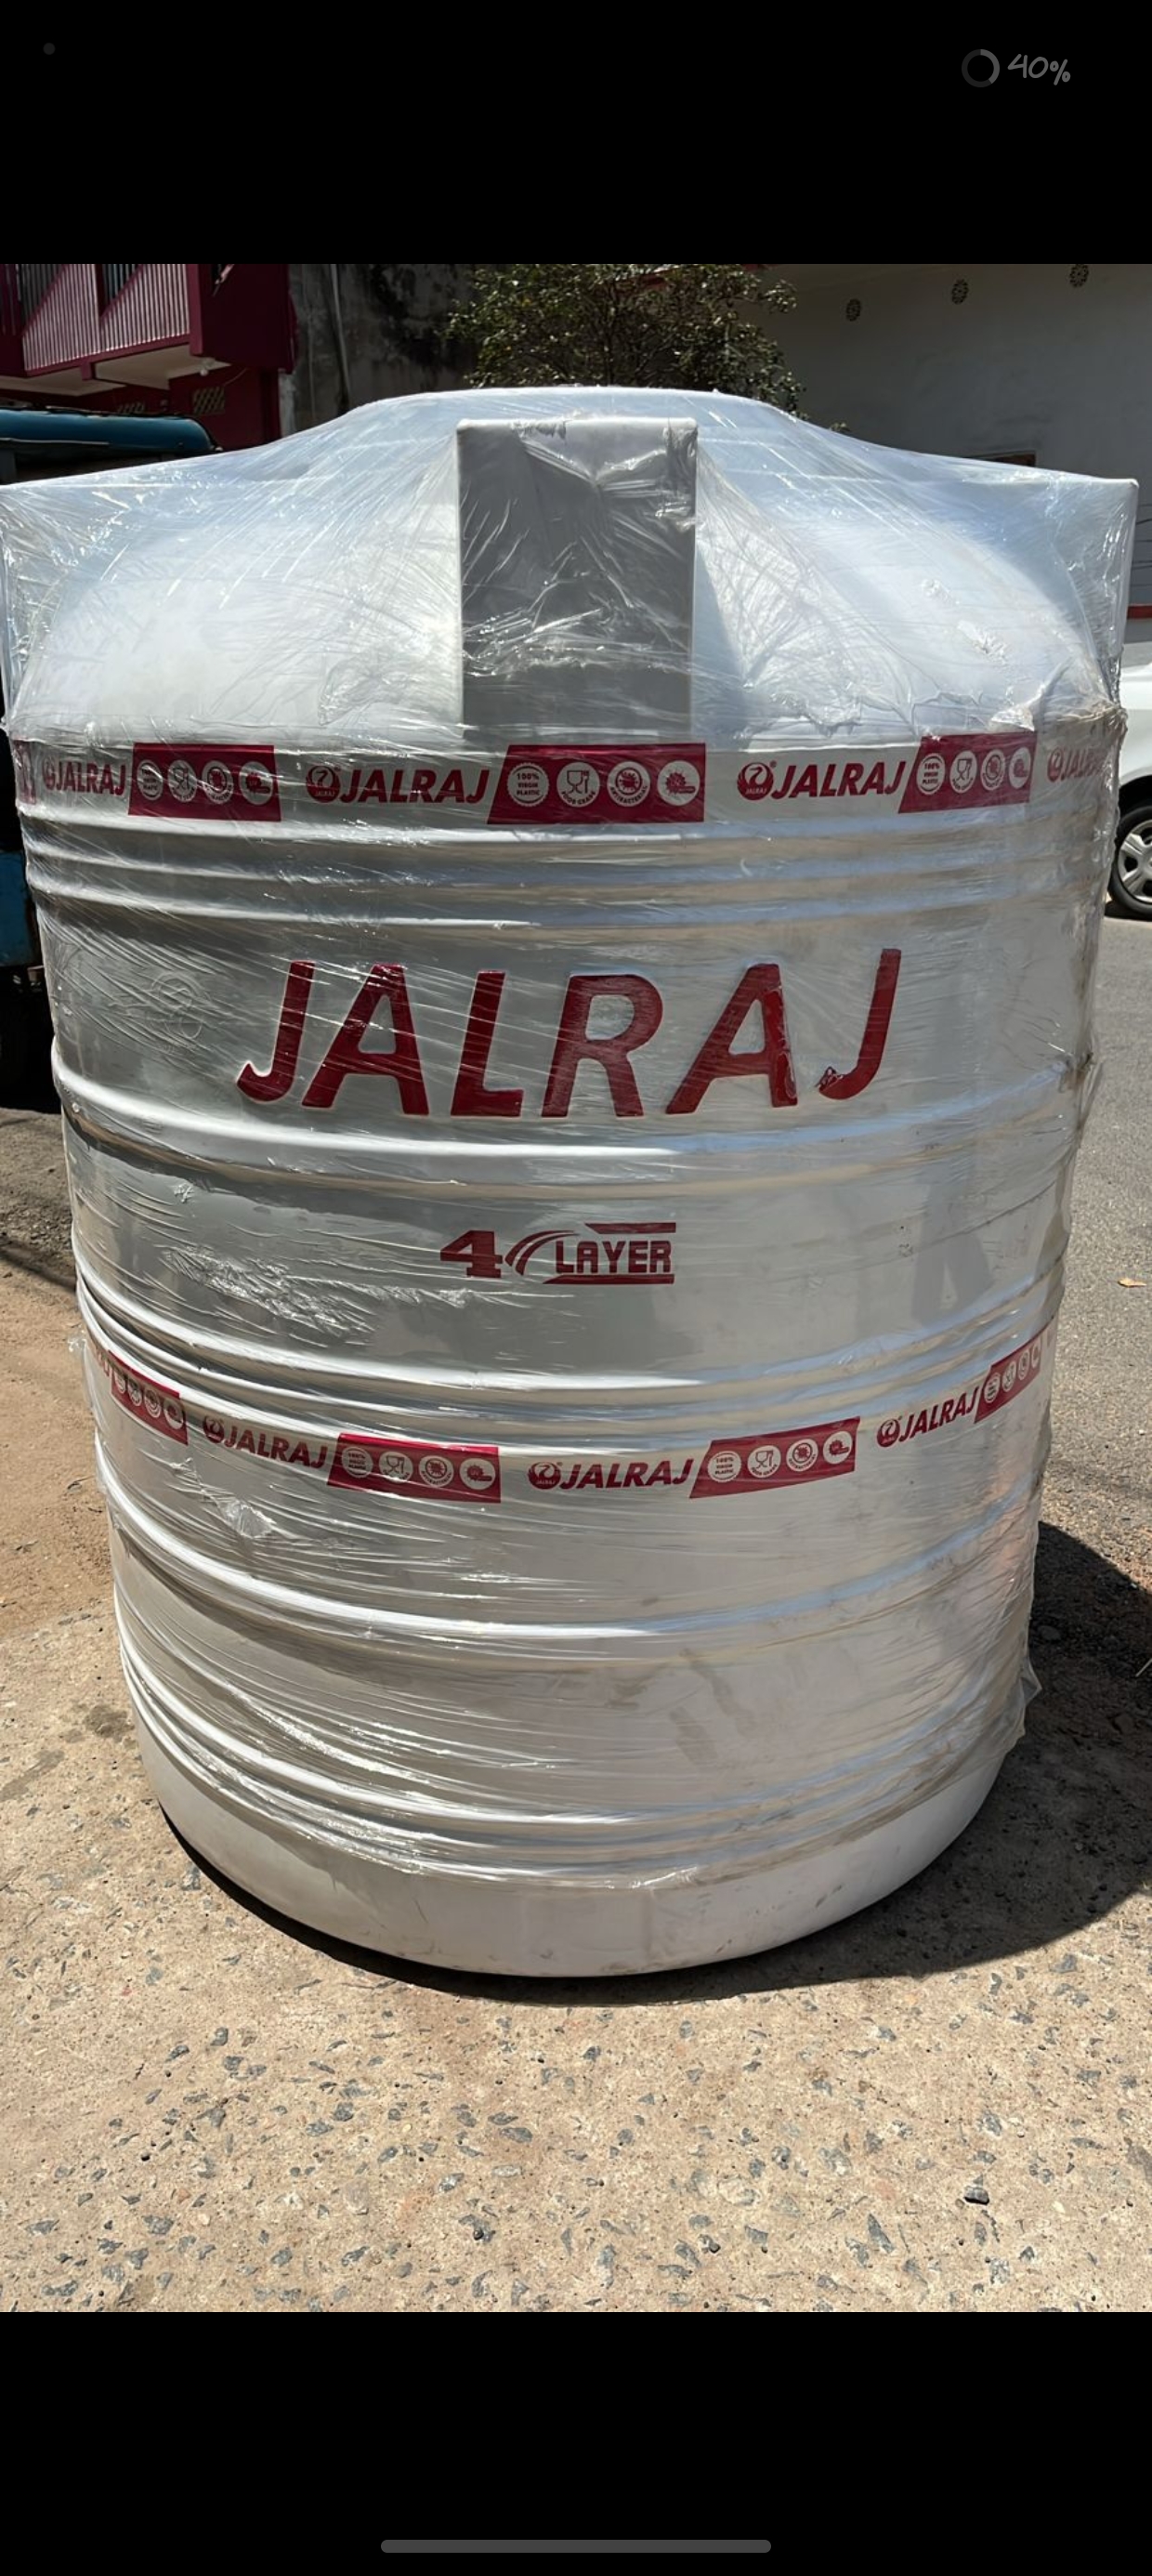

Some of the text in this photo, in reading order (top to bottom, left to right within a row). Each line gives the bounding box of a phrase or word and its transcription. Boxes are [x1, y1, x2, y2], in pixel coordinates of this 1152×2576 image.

[57, 760, 126, 795] JALRAJ
[340, 769, 490, 804] JALRAJ
[771, 760, 907, 800] JALRAJ
[235, 947, 902, 1120] JALRAJ
[439, 1229, 673, 1279] 4 LAYER
[898, 1386, 980, 1443] JALRAJ
[224, 1425, 329, 1469] JALRAJ
[559, 1457, 694, 1490] JALRAJ
